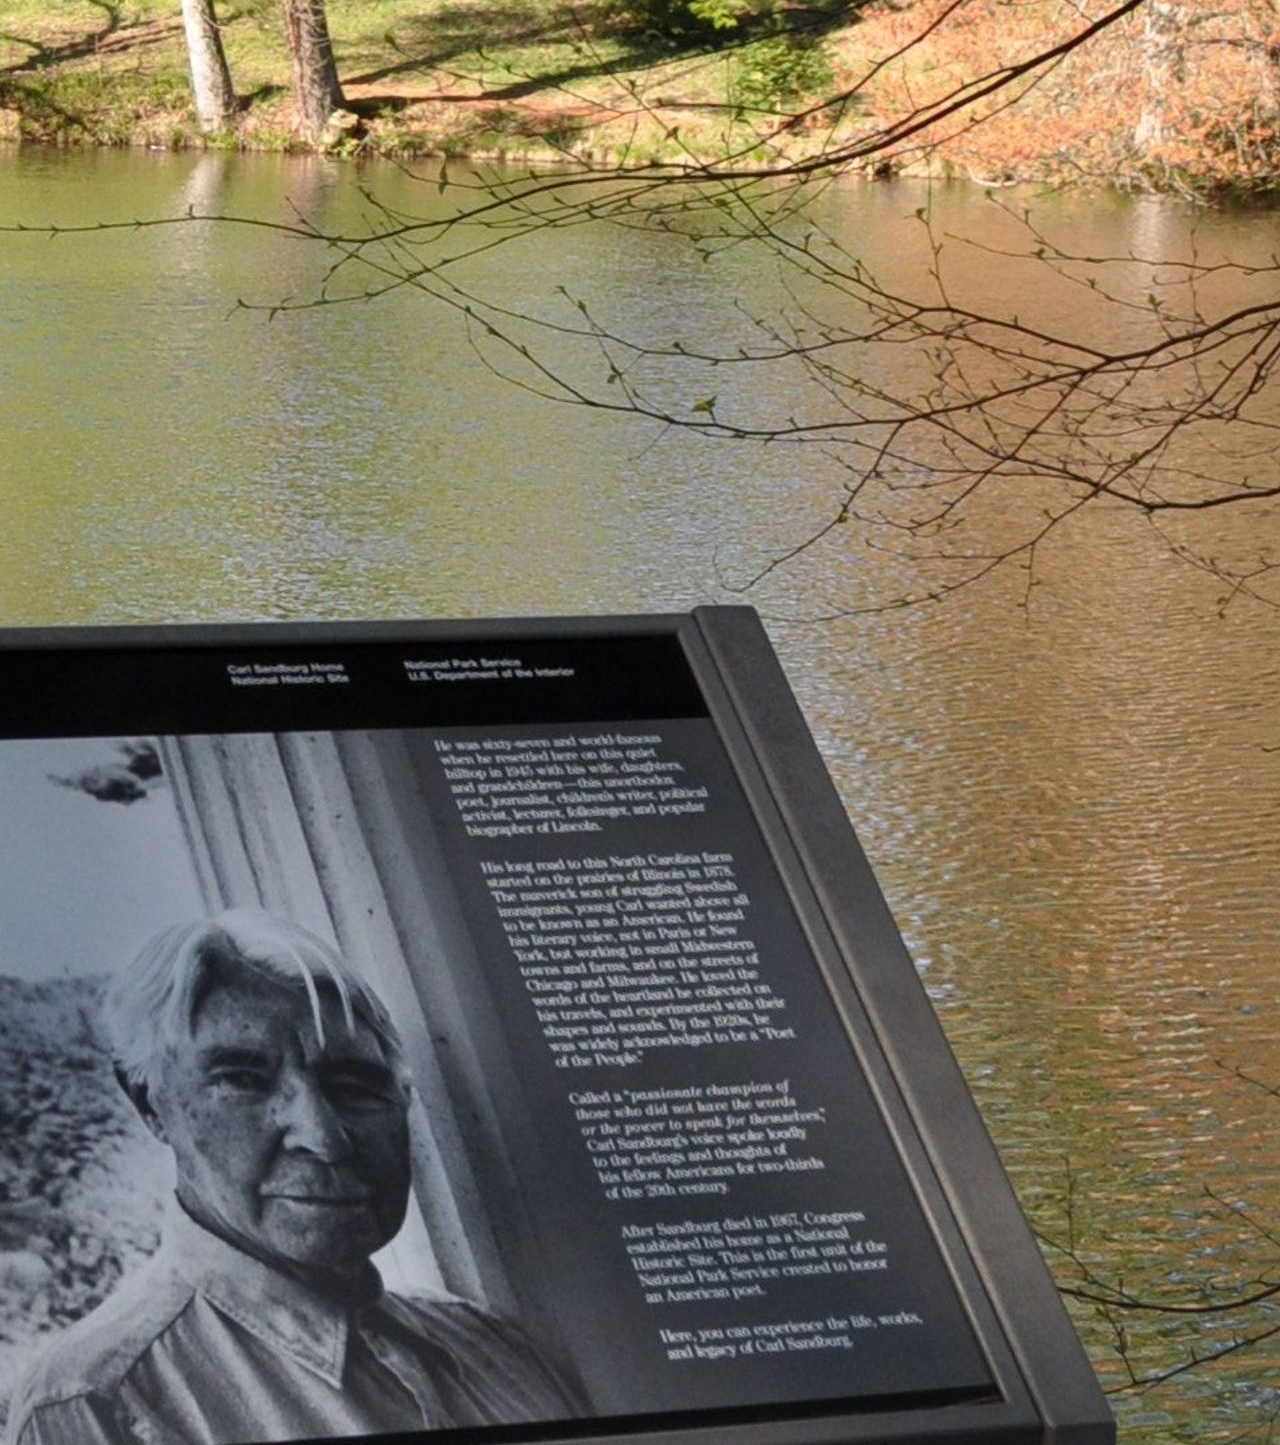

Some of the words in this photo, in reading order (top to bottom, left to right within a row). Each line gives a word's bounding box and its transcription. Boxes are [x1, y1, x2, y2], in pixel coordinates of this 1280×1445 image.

[227, 664, 252, 675] Carl
[465, 823, 534, 837] biographer
[568, 1090, 611, 1105] Called
[705, 1081, 773, 1097] champion
[575, 1108, 610, 1121] those
[614, 1105, 642, 1117] who
[645, 1103, 668, 1116] did
[672, 1102, 694, 1114] not
[696, 1101, 728, 1112] have
[731, 1098, 752, 1110] the
[755, 1093, 797, 1108] words
[580, 1126, 596, 1136] or
[599, 1123, 620, 1135] the
[625, 1122, 665, 1136] power
[685, 1116, 723, 1131] speak
[726, 1115, 745, 1129] for
[586, 1138, 615, 1152] Carl
[690, 1133, 724, 1144] voice
[727, 1129, 765, 1144] spoke
[766, 1125, 807, 1140] loudly
[592, 1156, 608, 1168] to
[610, 1154, 631, 1166] the
[634, 1152, 686, 1165] feelings
[688, 1148, 713, 1161] and
[714, 1145, 772, 1160] thoughts
[598, 1170, 621, 1184] his
[622, 1169, 660, 1182] fellow
[667, 1166, 735, 1179] Americans
[736, 1162, 755, 1175] for
[621, 1186, 644, 1199] the
[645, 1183, 677, 1197] 20th
[622, 1224, 654, 1238] After
[655, 1220, 722, 1235] Sandburg
[722, 1216, 752, 1231] died
[752, 1216, 769, 1229] in
[803, 1211, 866, 1225] Congress
[625, 1237, 701, 1255] established
[702, 1237, 725, 1249] his
[725, 1235, 763, 1247] home
[766, 1235, 782, 1244] as
[794, 1225, 850, 1241] National
[630, 1257, 683, 1271] Historic
[718, 1251, 750, 1264] This
[766, 1248, 788, 1261] the
[790, 1246, 818, 1259] first
[821, 1244, 847, 1256] unit
[865, 1240, 888, 1253] the
[637, 1271, 695, 1287] National
[696, 1269, 728, 1282] Park
[730, 1266, 780, 1280] Service
[782, 1261, 832, 1277] created
[832, 1262, 848, 1272] to
[847, 1258, 888, 1271] honor
[644, 1292, 664, 1304] an
[667, 1287, 730, 1302] American
